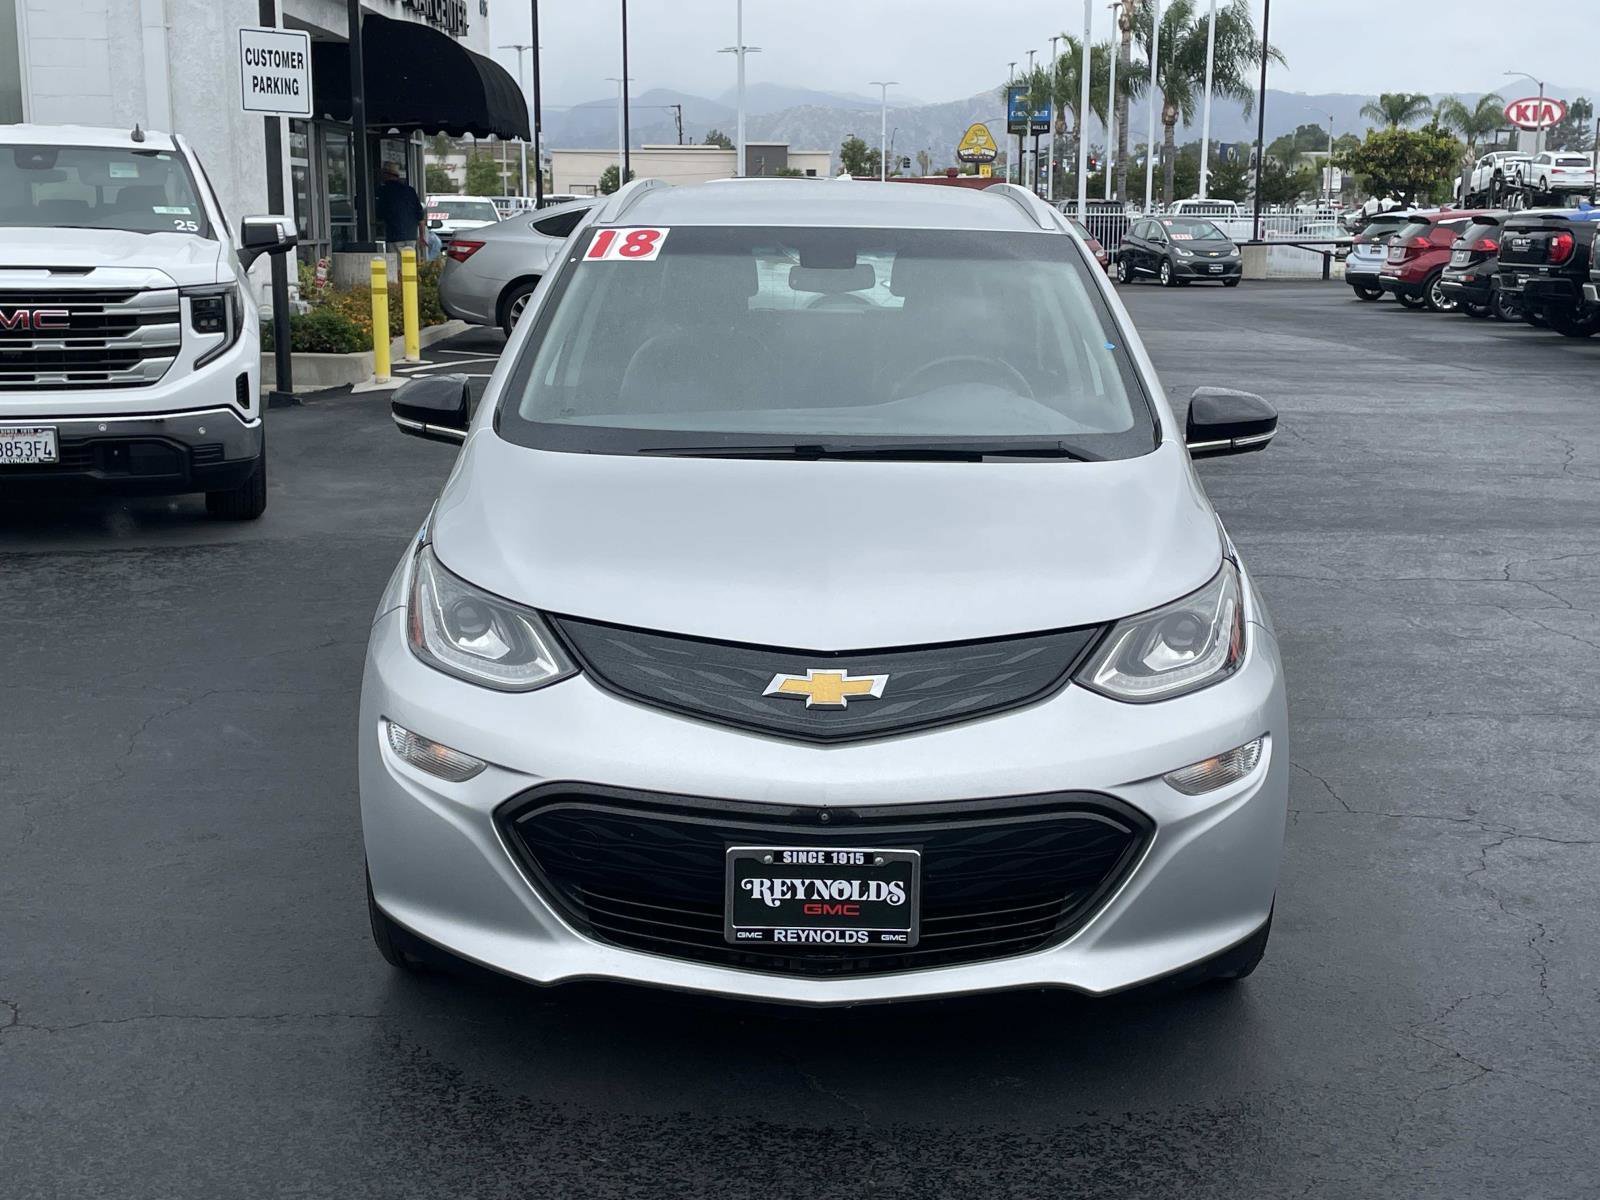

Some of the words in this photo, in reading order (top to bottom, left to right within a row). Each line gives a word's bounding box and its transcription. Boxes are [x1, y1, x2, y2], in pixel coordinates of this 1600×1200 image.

[245, 47, 304, 69] CUSTOMER
[252, 75, 300, 96] PARKING
[1516, 104, 1555, 122] KIA
[173, 219, 199, 232] 25
[587, 229, 662, 259] 18
[783, 851, 825, 864] SINCE
[831, 852, 864, 865] 1915
[741, 878, 906, 908] REYNOLDS
[803, 903, 860, 916] GMC
[737, 931, 763, 939] GMC
[774, 929, 869, 943] REYNOLDS
[881, 933, 907, 941] GMC
